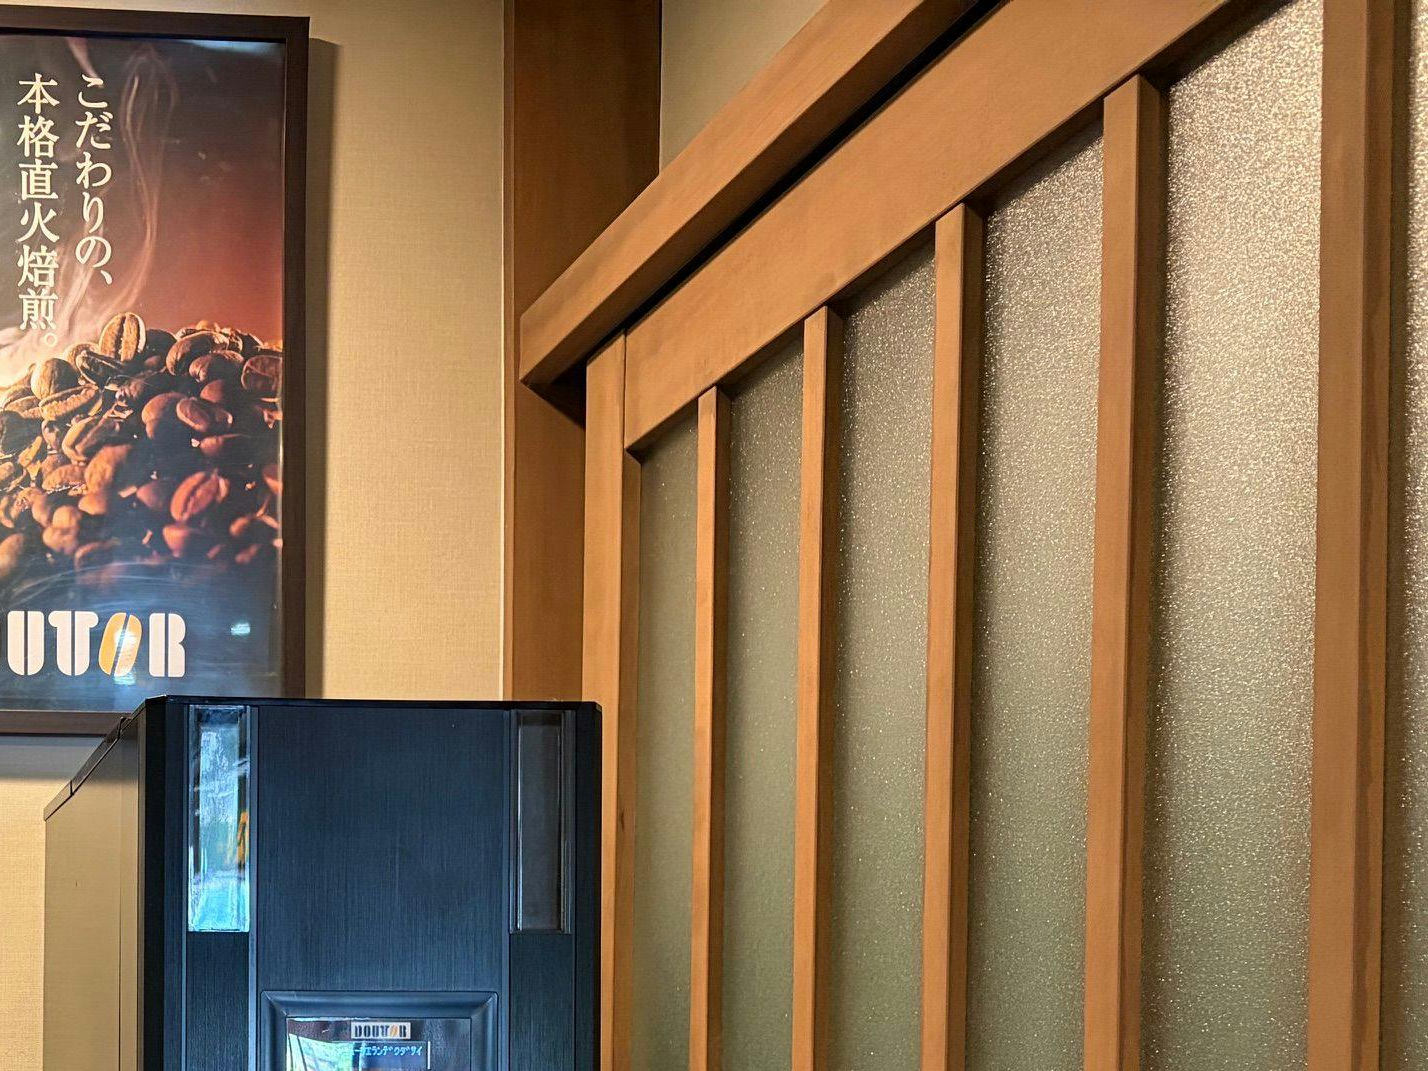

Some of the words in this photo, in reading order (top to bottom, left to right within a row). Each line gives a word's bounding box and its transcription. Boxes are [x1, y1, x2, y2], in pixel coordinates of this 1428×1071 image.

[17, 72, 60, 348] 本格直火焙煎。
[75, 72, 113, 285] こだわりの、
[355, 1025, 407, 1038] DOUTOR
